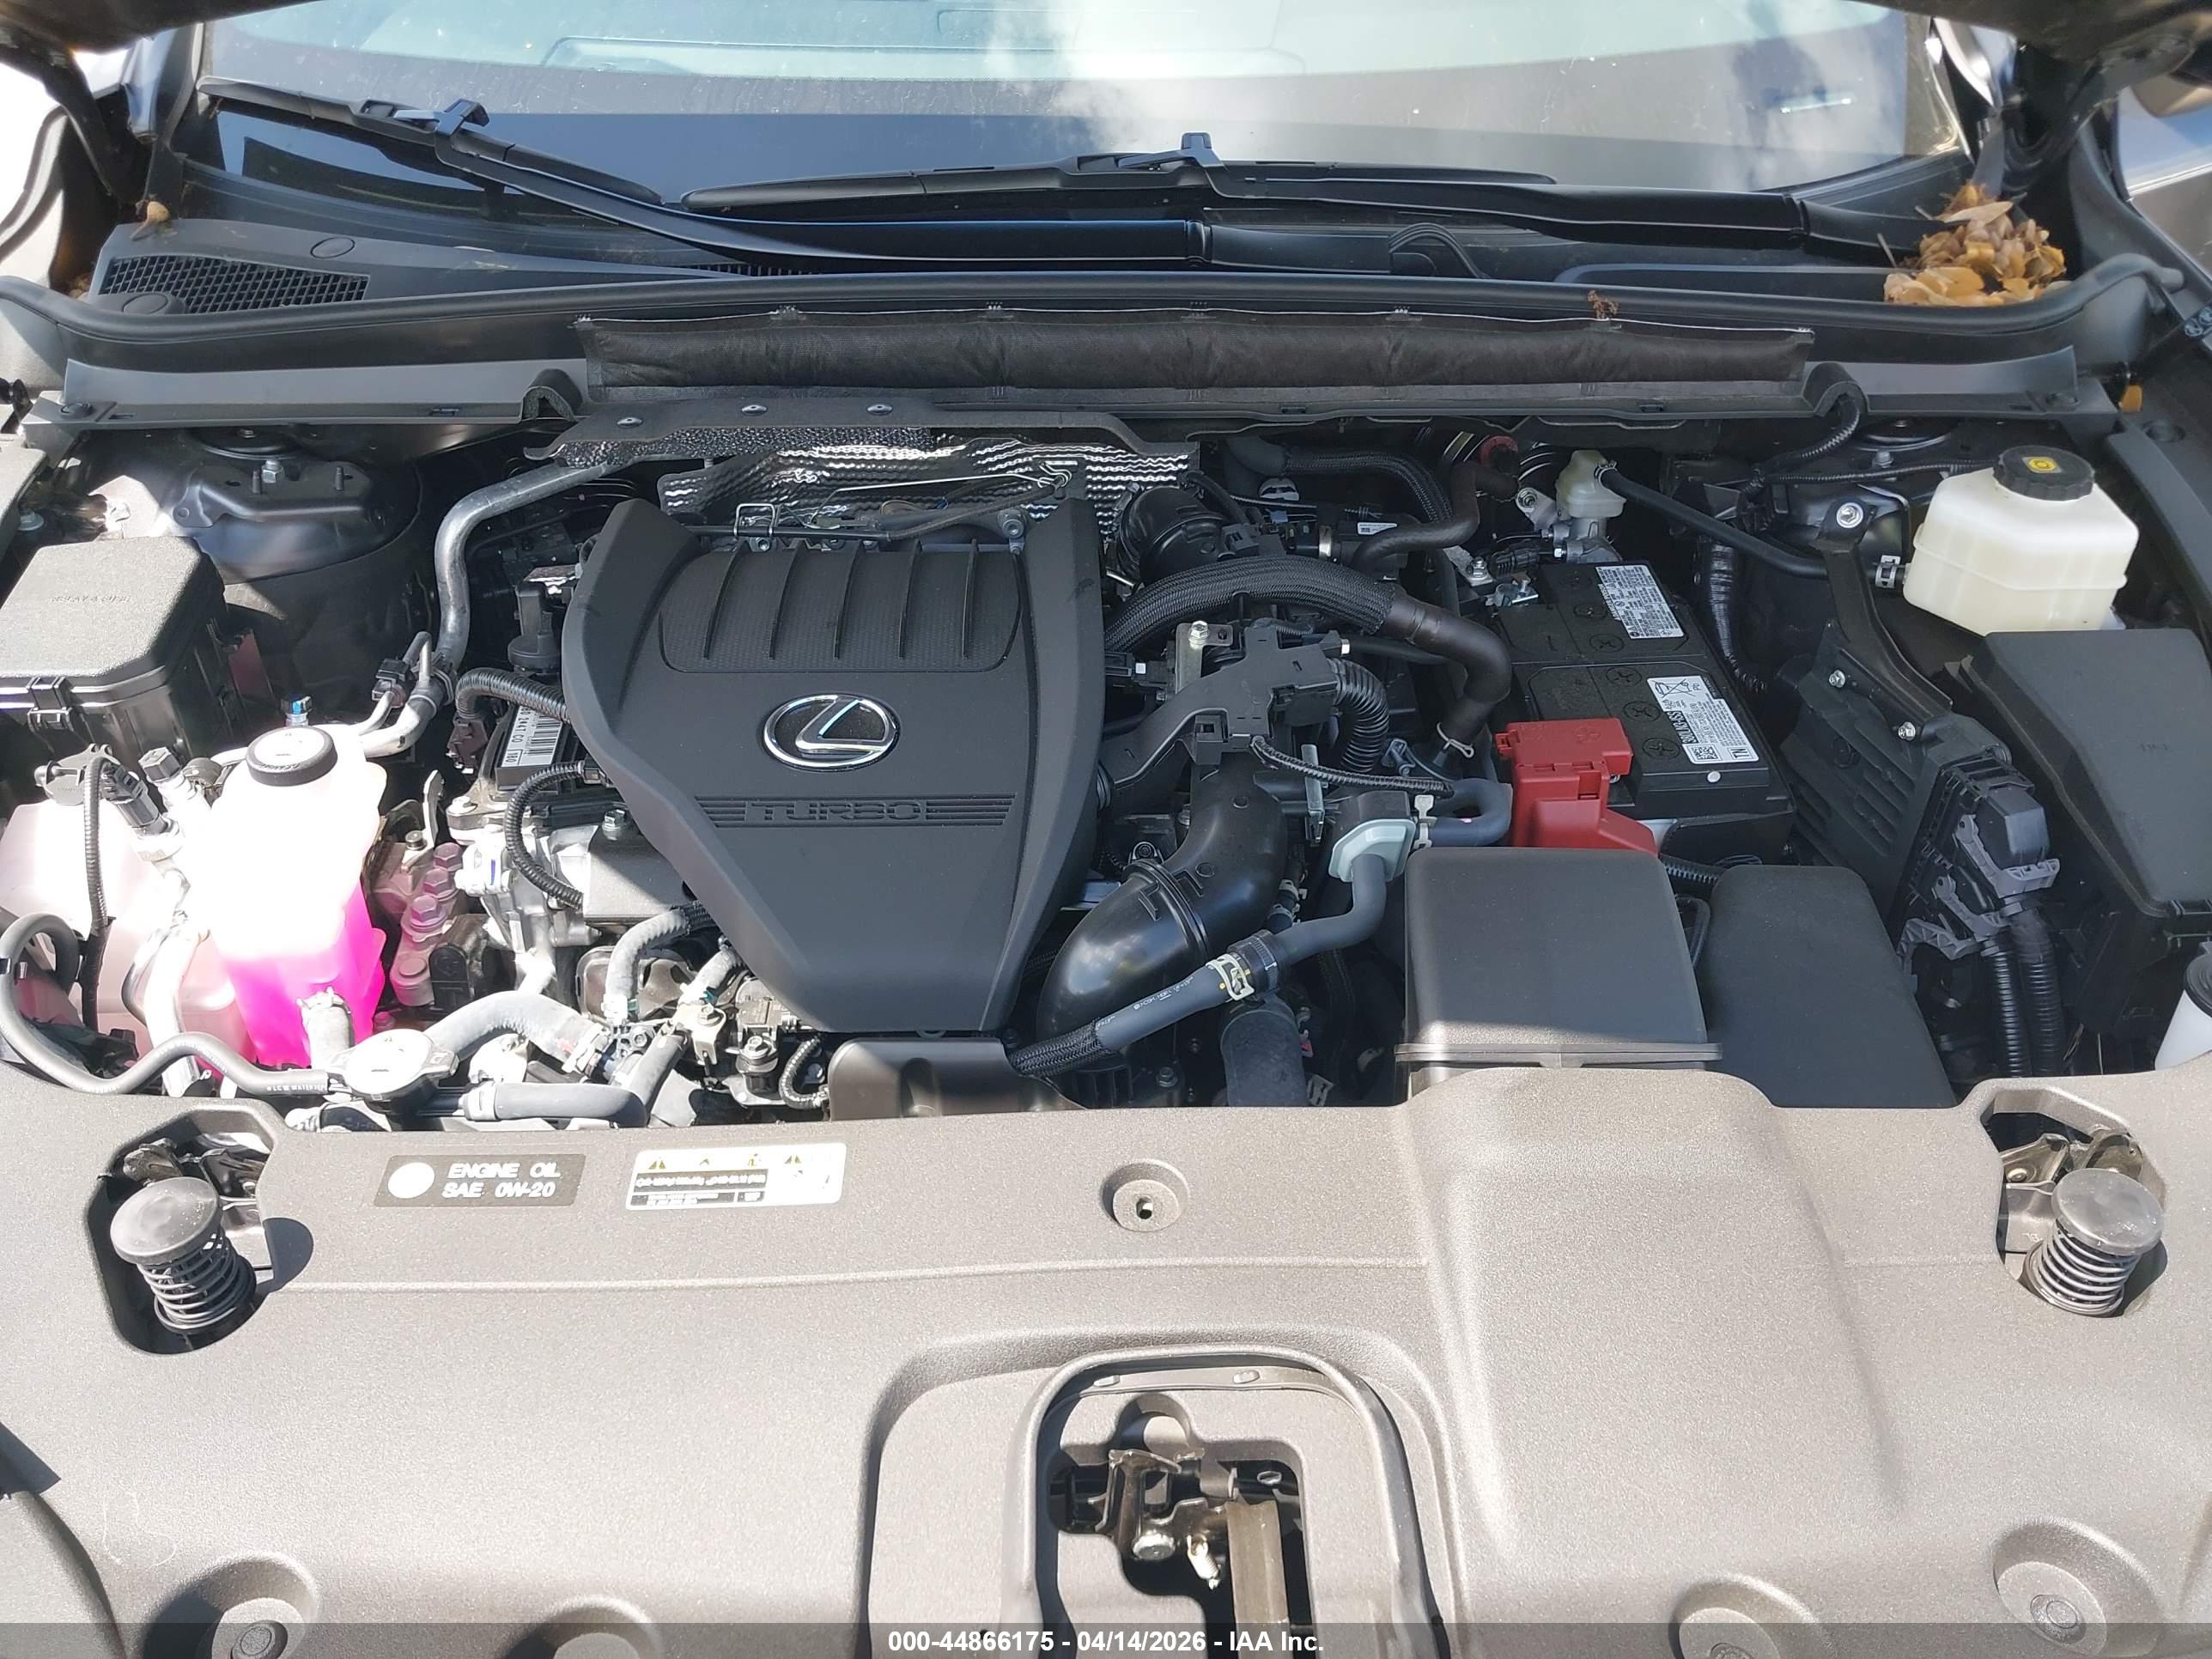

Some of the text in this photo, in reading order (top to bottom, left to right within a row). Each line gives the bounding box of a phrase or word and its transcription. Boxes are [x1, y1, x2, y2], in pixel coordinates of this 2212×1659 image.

[750, 800, 922, 821] TURBO
[447, 1162, 562, 1178] ENGINE OIL
[441, 1181, 556, 1198] SAE 0W-20
